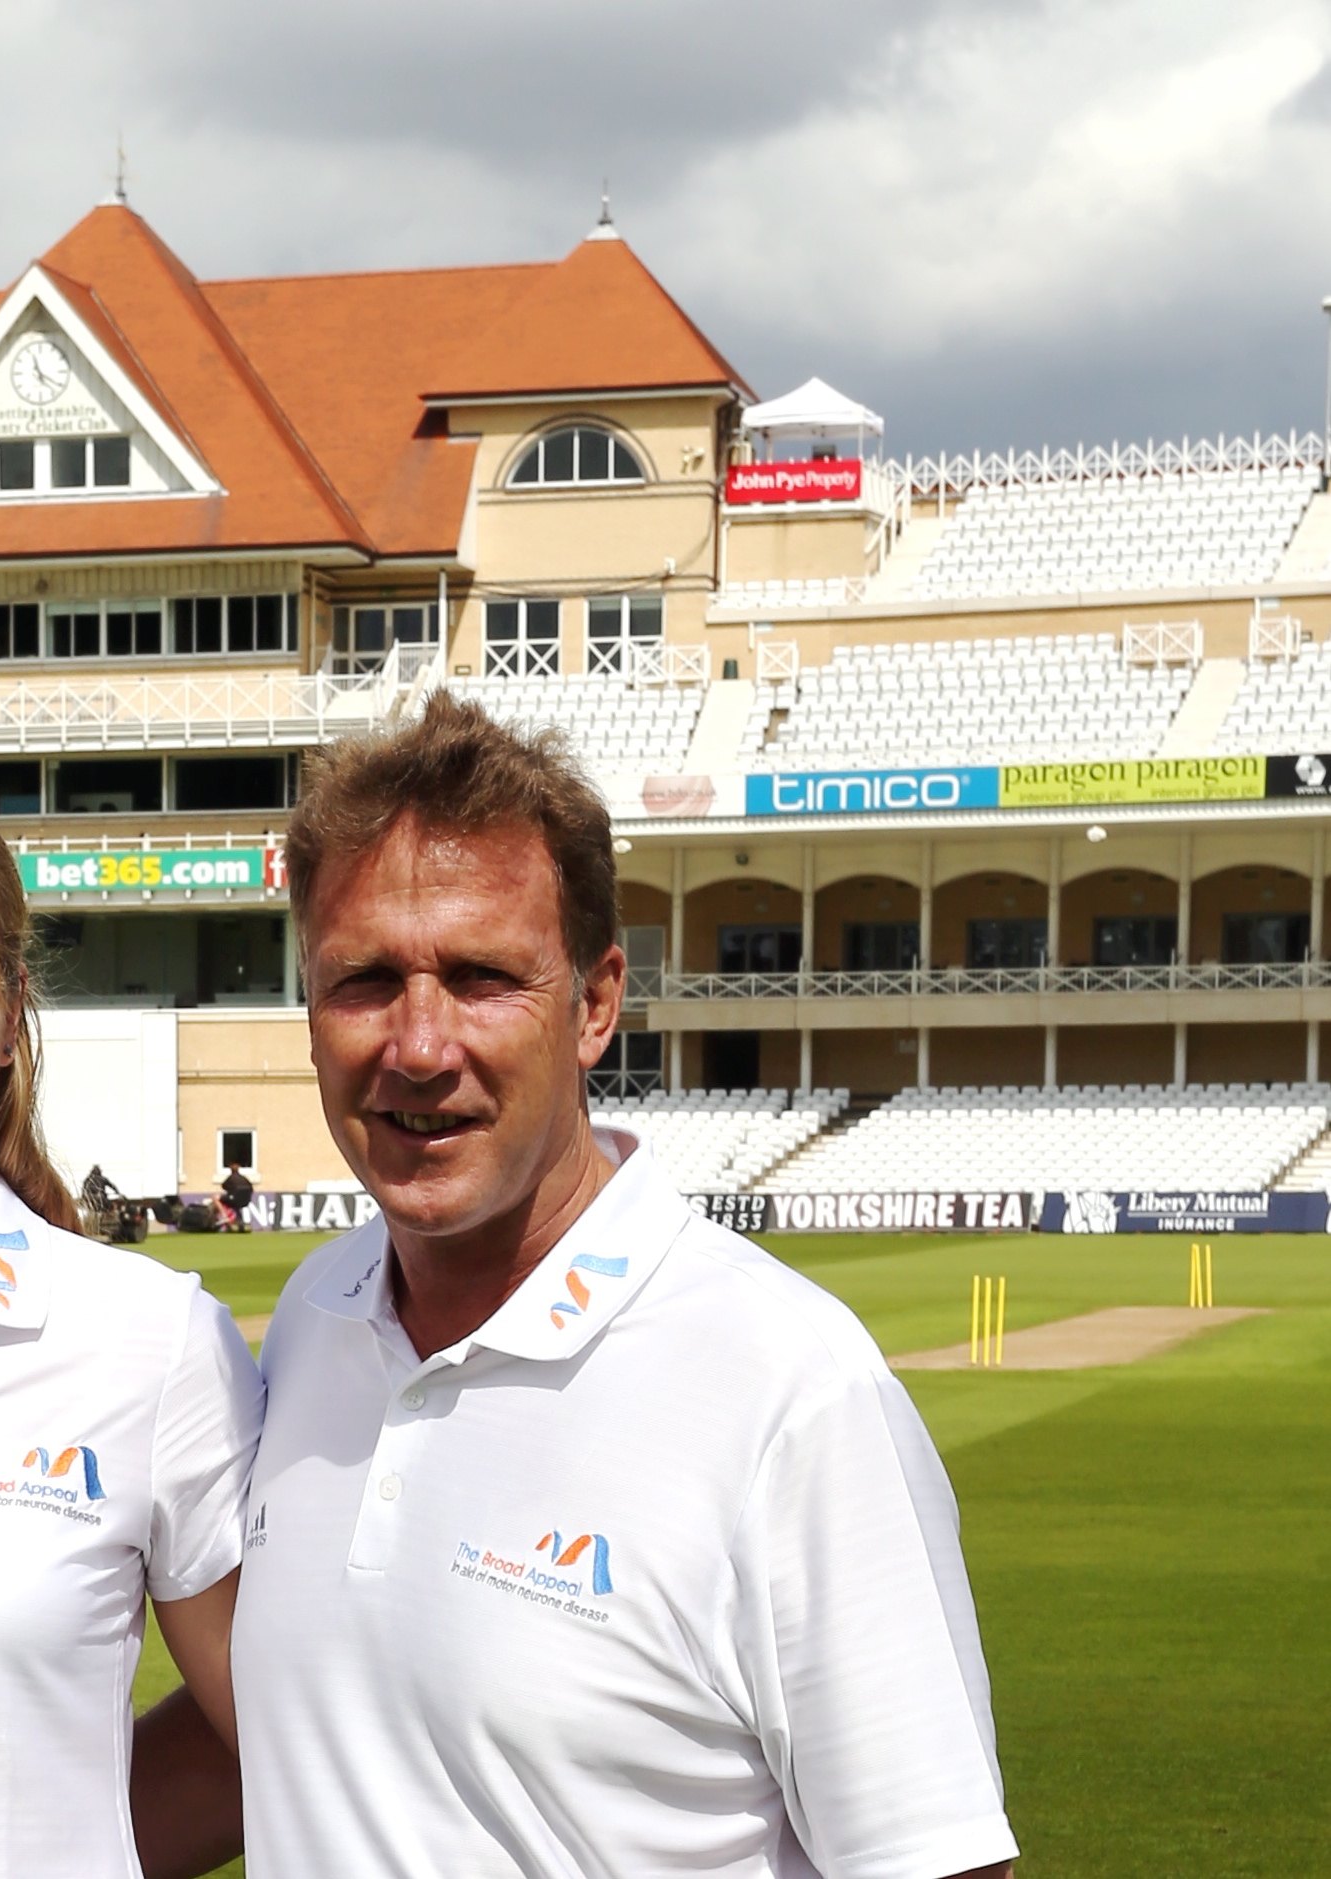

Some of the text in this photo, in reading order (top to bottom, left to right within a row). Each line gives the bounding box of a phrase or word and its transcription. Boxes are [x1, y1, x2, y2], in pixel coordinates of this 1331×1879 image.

[26, 419, 73, 433] Cricket
[78, 417, 108, 431] Club
[731, 472, 774, 490] John
[775, 471, 806, 491] Pye
[1004, 757, 1259, 793] paragon paragon
[773, 774, 960, 811] timico
[36, 855, 250, 887] bet365.com
[712, 1194, 766, 1212] ESTD
[773, 1193, 1024, 1229] YORKSHIRE TEA
[1193, 1192, 1269, 1212] Mutual
[710, 1212, 763, 1231] 1853
[19, 1481, 79, 1504] Appeal
[15, 1498, 62, 1516] neurone
[63, 1505, 102, 1526] disease
[456, 1541, 583, 1598] The Broad Appeal
[460, 1564, 475, 1579] aid
[475, 1570, 486, 1583] of
[486, 1573, 518, 1594] motor
[518, 1587, 562, 1609] neurone
[563, 1600, 610, 1624] disease
